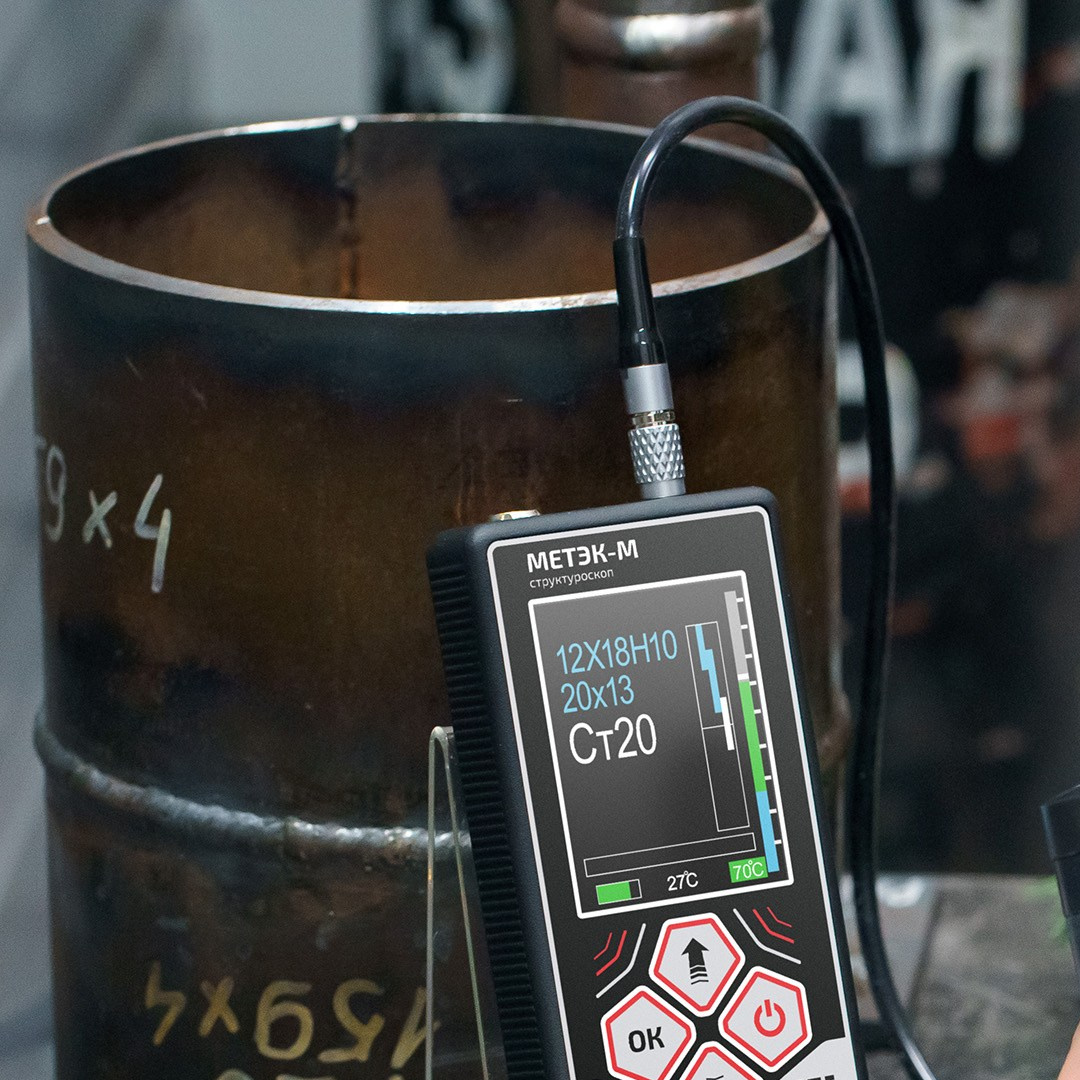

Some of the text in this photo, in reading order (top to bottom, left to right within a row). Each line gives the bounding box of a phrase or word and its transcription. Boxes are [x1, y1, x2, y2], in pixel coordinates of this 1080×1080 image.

[526, 539, 639, 573] МЕТЭК-М
[529, 567, 614, 589] структуроскоп
[556, 629, 677, 675] 12Х18Н10
[569, 713, 657, 764] Ст20
[627, 1026, 665, 1054] OK
